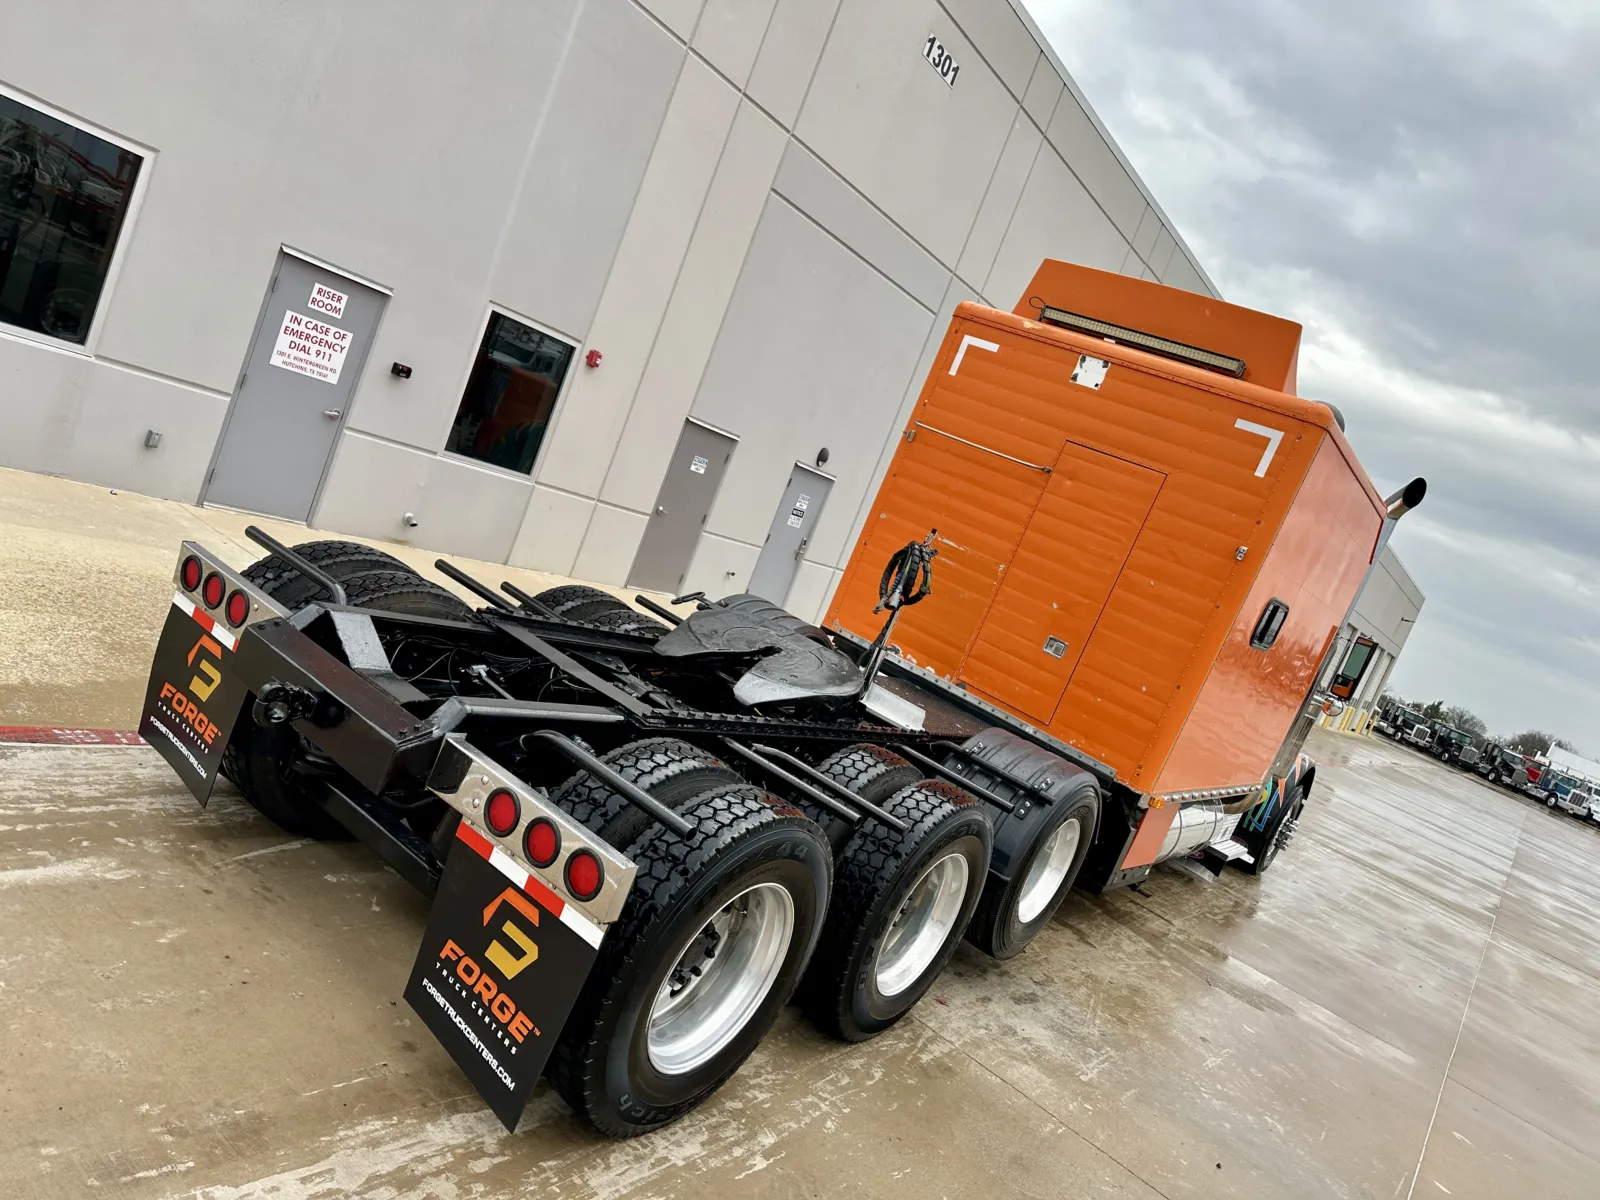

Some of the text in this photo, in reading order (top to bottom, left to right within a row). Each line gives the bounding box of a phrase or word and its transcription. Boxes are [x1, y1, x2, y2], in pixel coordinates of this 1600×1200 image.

[926, 36, 960, 87] 1301
[310, 296, 342, 316] ROOM
[316, 287, 343, 304] RISER
[283, 325, 347, 354] EMERGENCY
[288, 340, 332, 362] DIAL 911
[289, 314, 348, 342] IN CASE OF
[293, 355, 329, 371] WINTERGREEN
[157, 700, 180, 724] TRUCK
[182, 722, 209, 754] CENTERS
[159, 681, 219, 746] FORGE
[149, 715, 208, 780] FORGETRUCKCENTERS.COM
[435, 961, 517, 1055] TRUCK CENTERS
[439, 938, 534, 1044] FORGE
[421, 977, 516, 1092] FORGETRUCKCENTERS.COM
